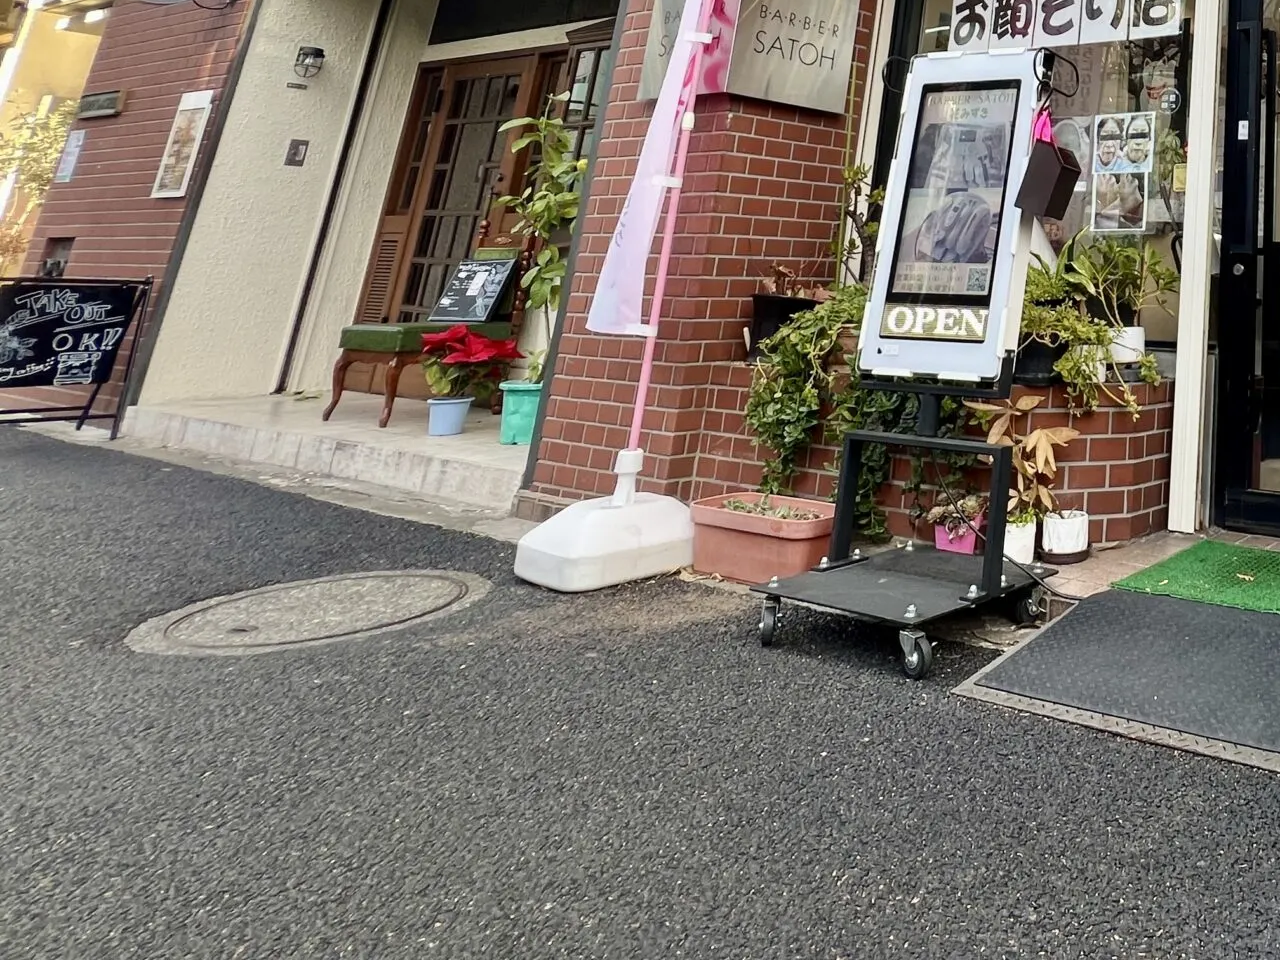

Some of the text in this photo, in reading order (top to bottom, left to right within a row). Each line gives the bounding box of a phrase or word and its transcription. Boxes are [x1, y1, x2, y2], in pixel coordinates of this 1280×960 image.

[753, 29, 837, 71] SATOH
[977, 91, 1015, 105] SATOH
[14, 288, 80, 318] TAKE
[63, 302, 113, 324] OUT
[887, 305, 990, 337] OPEN
